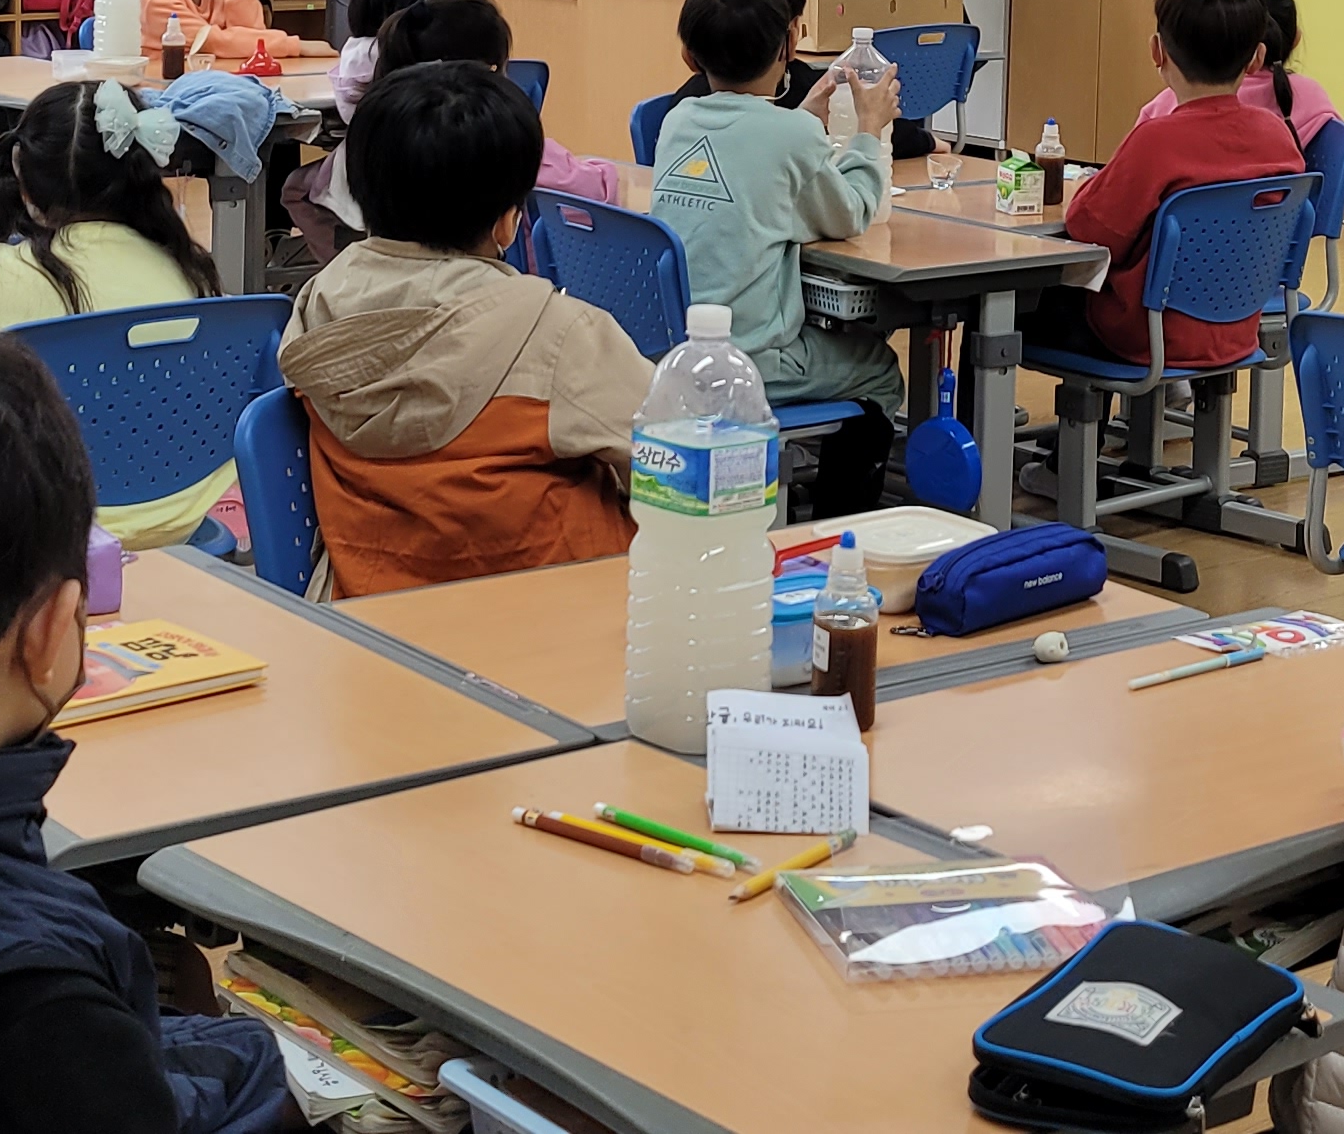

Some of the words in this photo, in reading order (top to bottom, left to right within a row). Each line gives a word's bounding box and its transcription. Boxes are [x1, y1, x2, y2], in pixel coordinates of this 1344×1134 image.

[658, 194, 716, 211] ATHLETIC
[637, 445, 681, 472] 삼다수
[1024, 579, 1037, 589] new
[1037, 572, 1063, 587] balance
